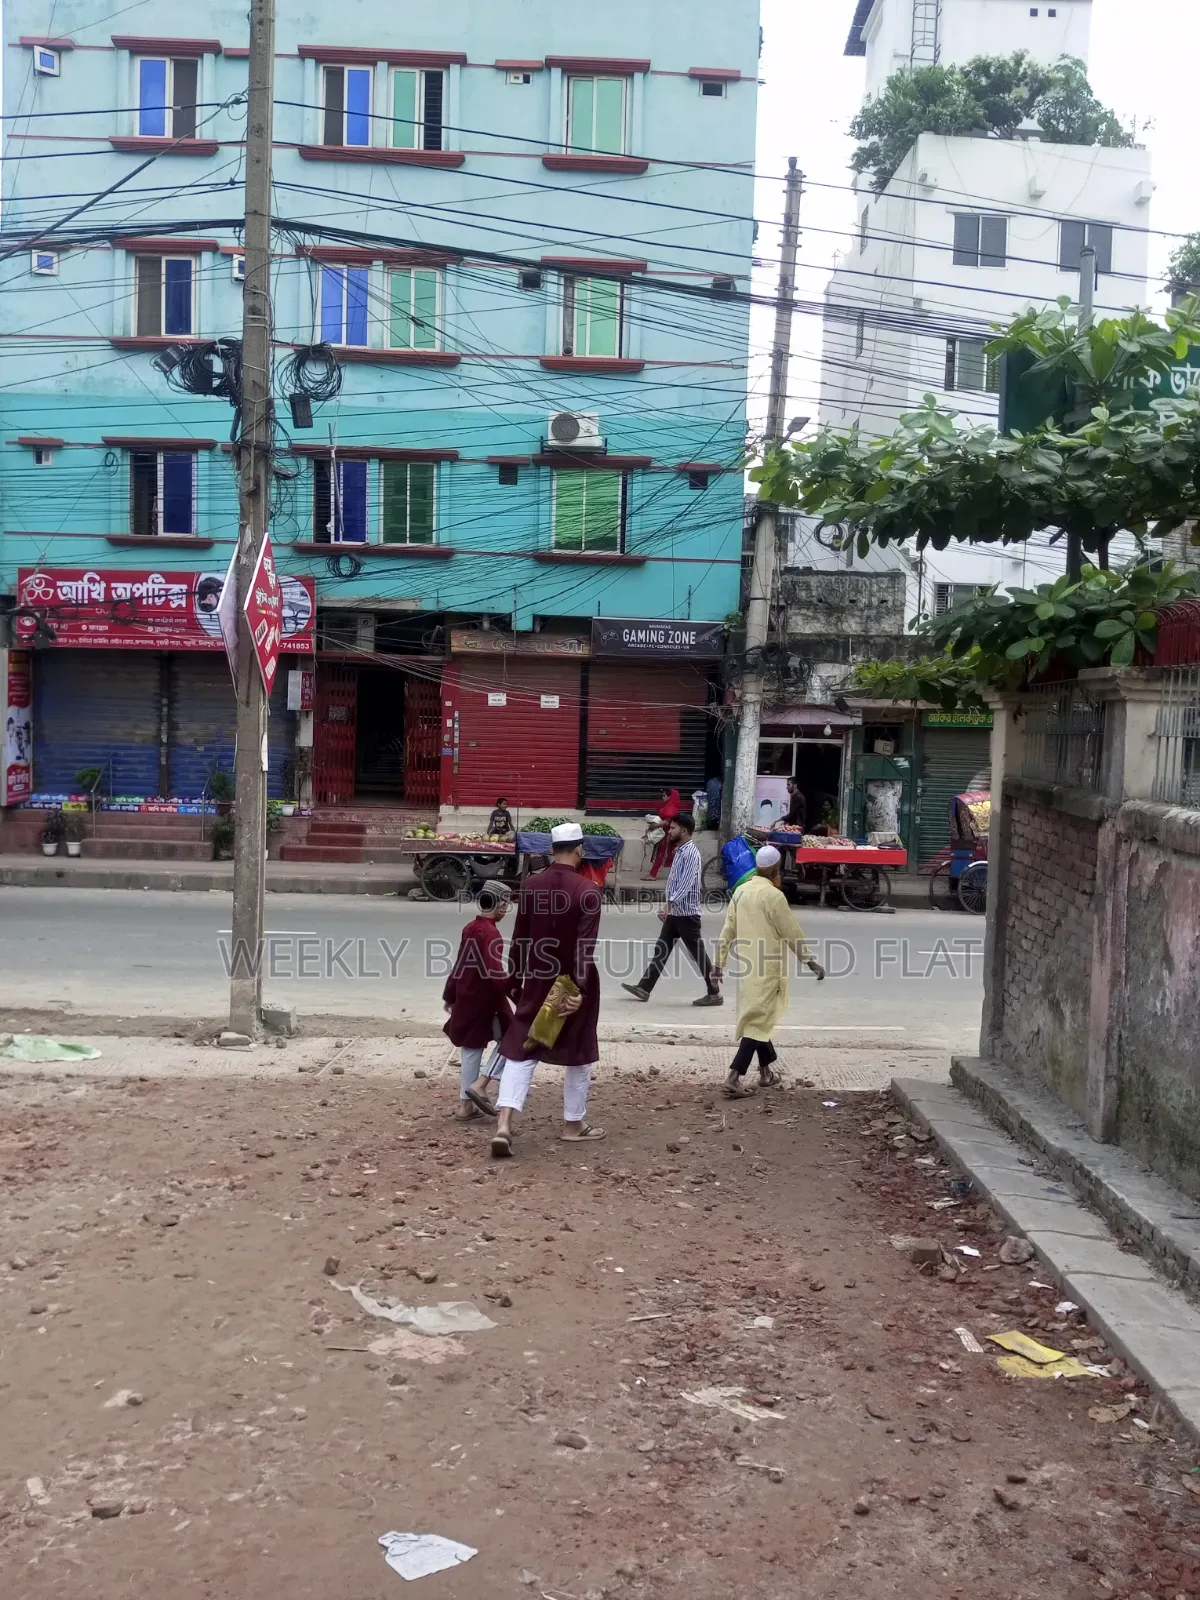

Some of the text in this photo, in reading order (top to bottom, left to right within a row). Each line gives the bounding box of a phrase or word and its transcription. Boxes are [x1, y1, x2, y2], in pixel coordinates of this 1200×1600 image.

[622, 629, 697, 645] GAMING ZONE
[280, 642, 310, 650] -741853
